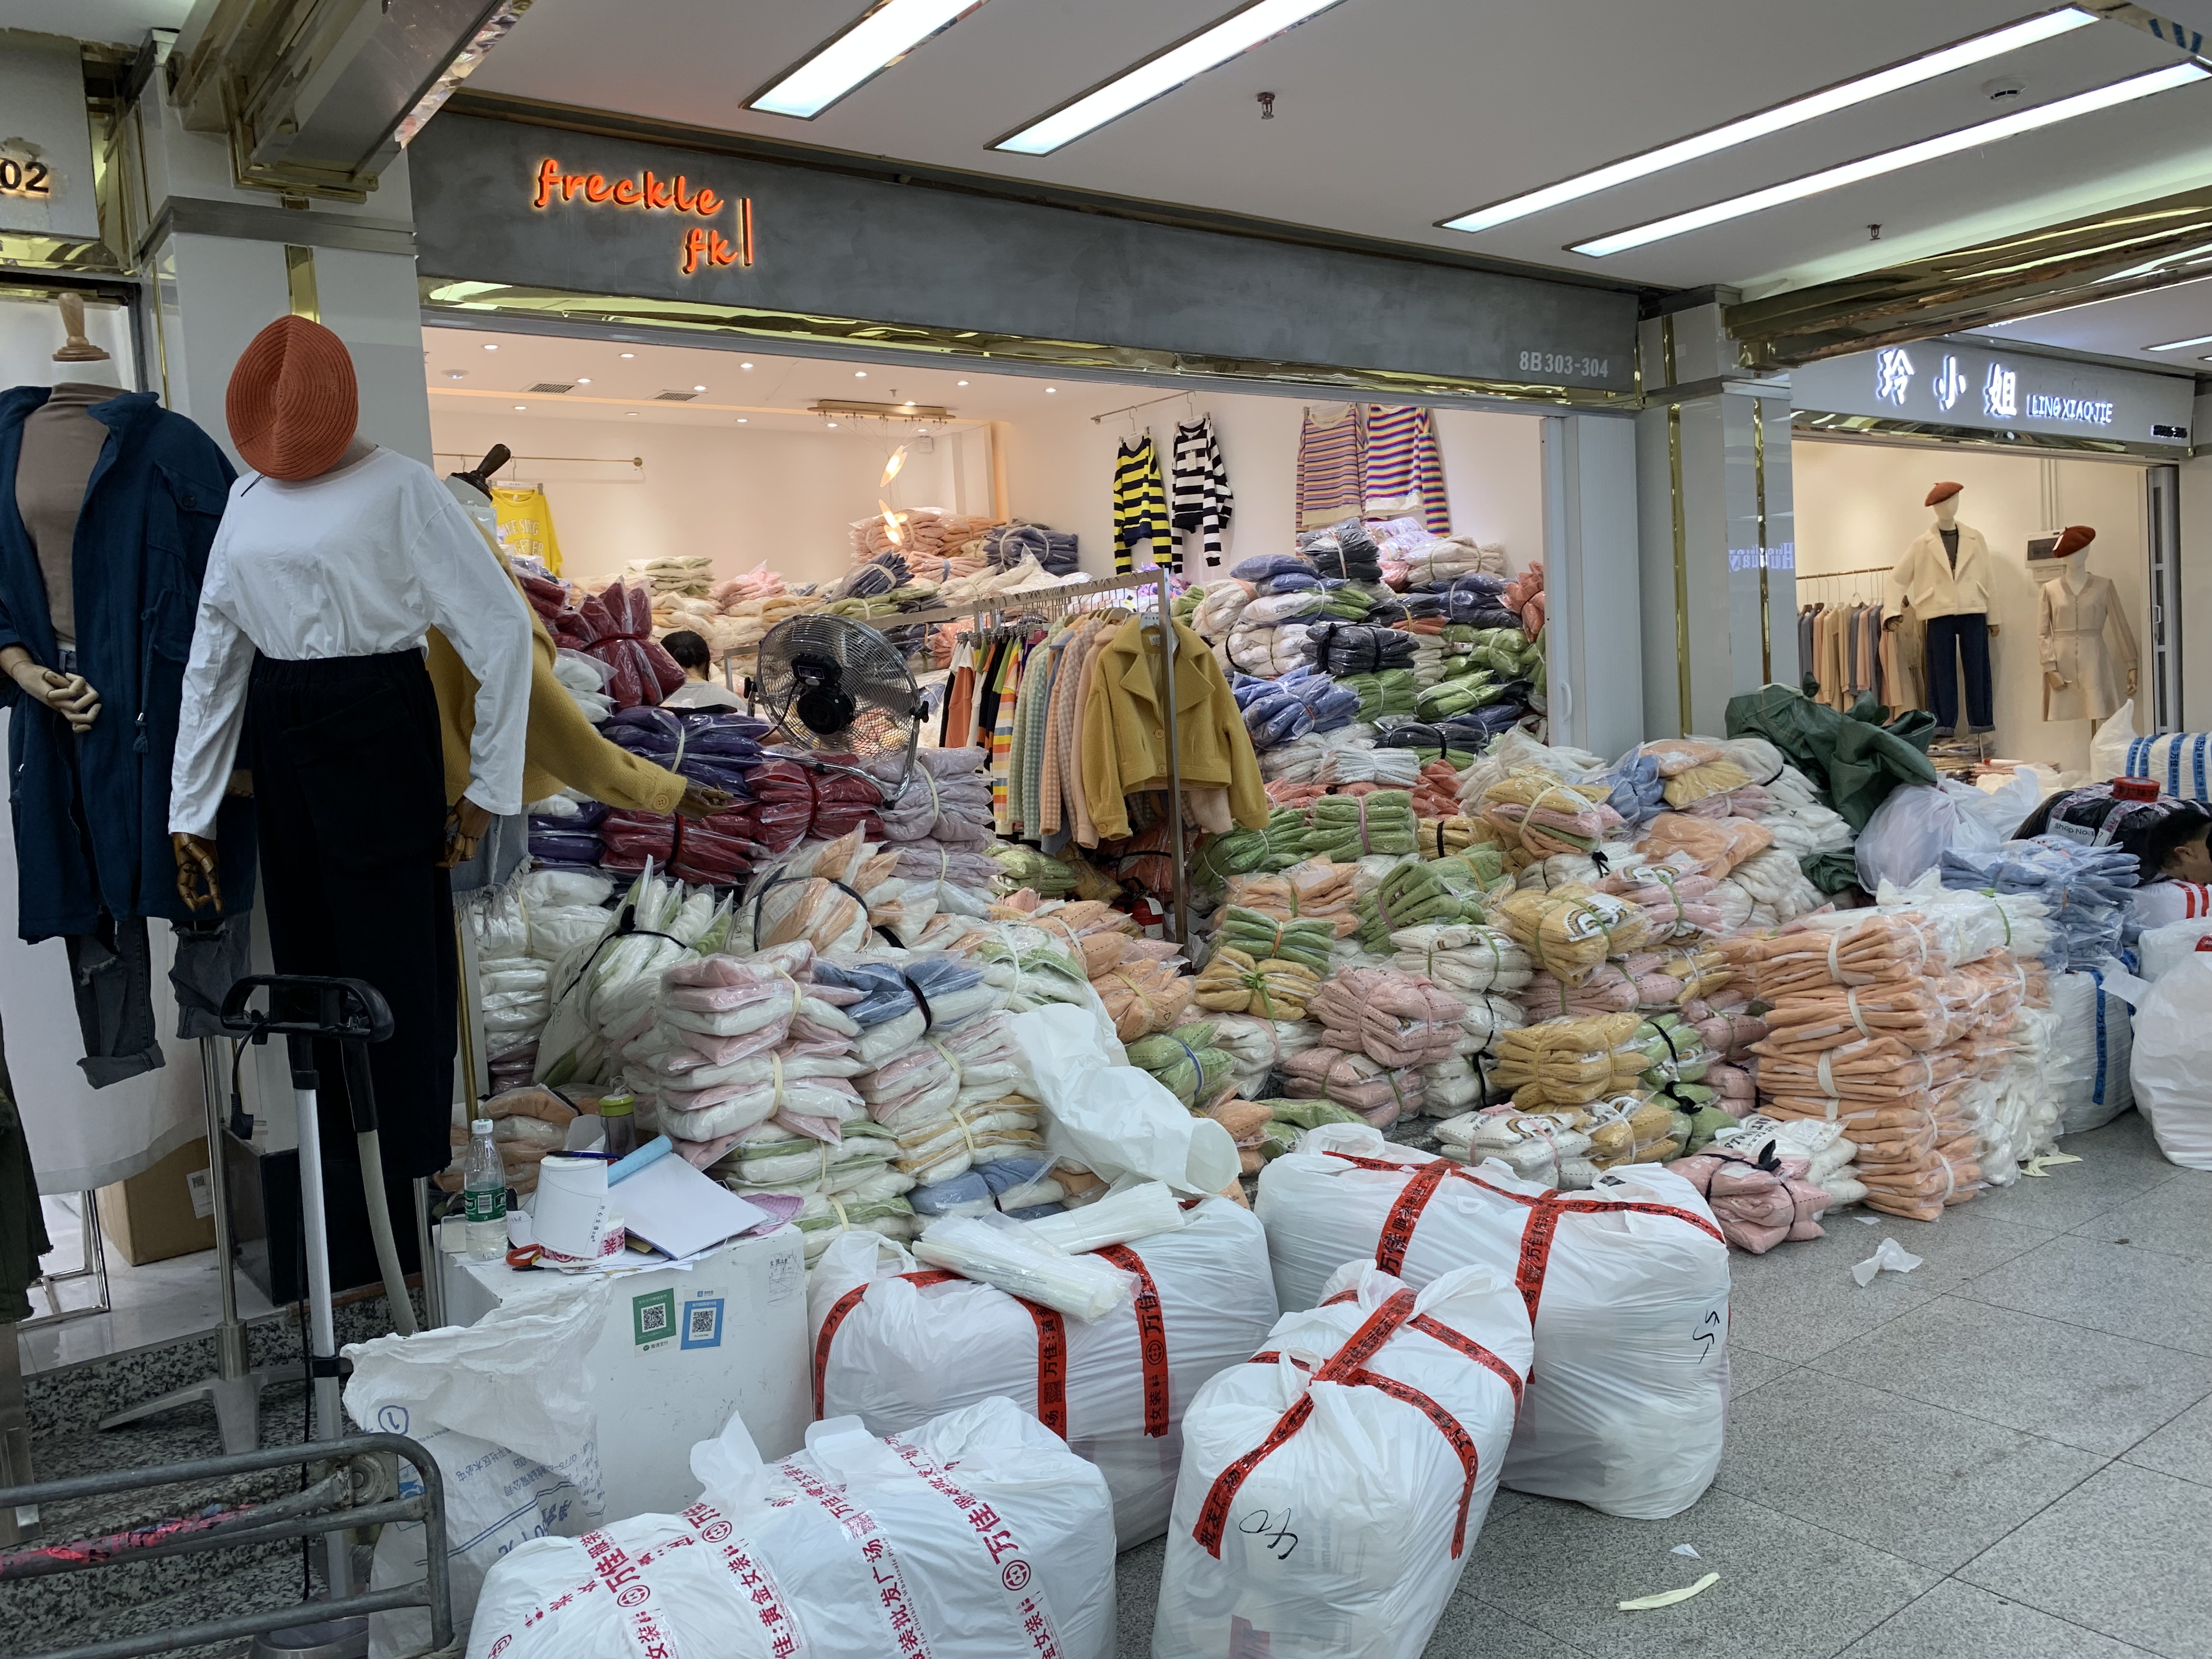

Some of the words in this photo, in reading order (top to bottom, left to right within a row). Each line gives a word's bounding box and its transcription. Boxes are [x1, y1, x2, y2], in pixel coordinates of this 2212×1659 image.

[0, 160, 49, 193] 02
[534, 159, 724, 216] freckle
[1876, 349, 2017, 417] 玲小姐
[2055, 822, 2074, 834] Shop
